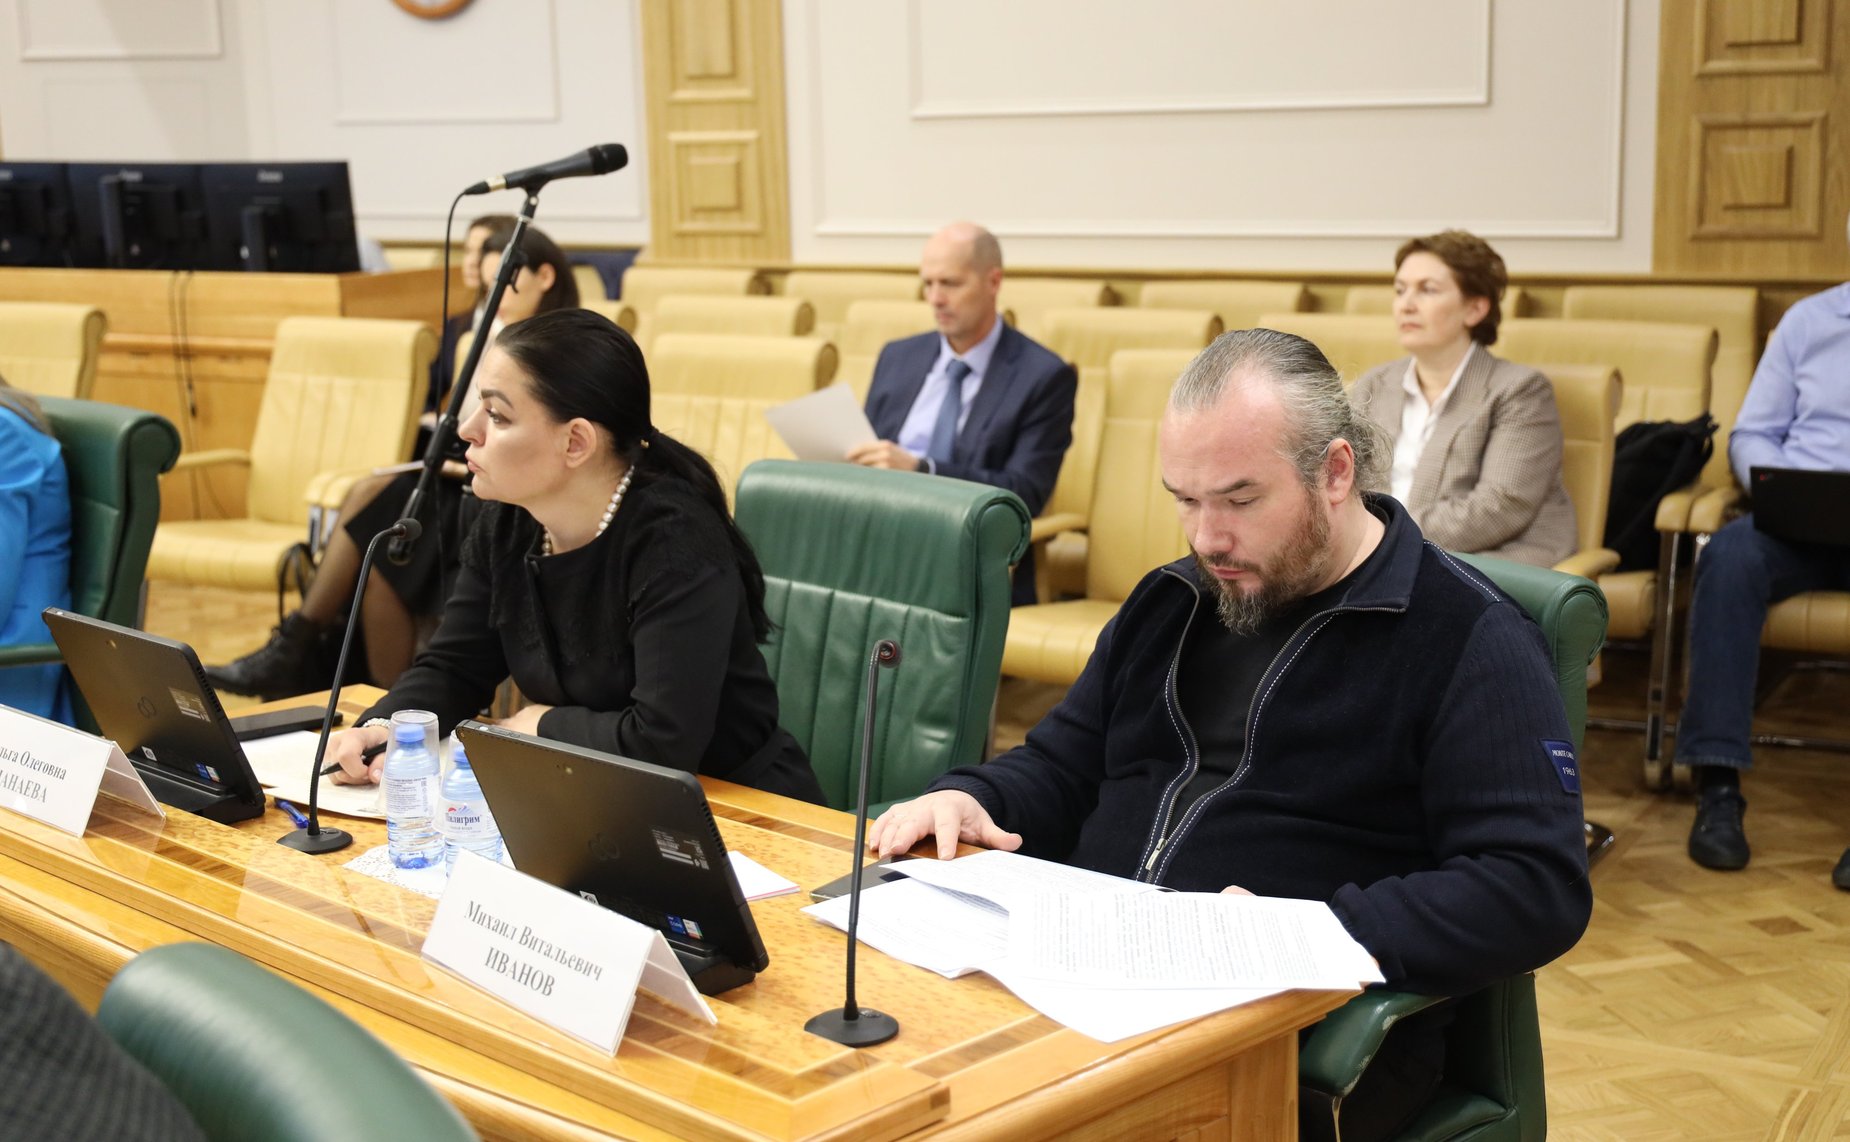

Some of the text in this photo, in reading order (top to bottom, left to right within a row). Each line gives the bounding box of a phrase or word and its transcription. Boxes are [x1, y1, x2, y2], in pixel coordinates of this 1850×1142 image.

[0, 769, 47, 803] АНАЕВА
[20, 750, 67, 781] Олеговна
[464, 900, 603, 981] Михаил Витальевич
[484, 947, 556, 997] ИВАНОВ
